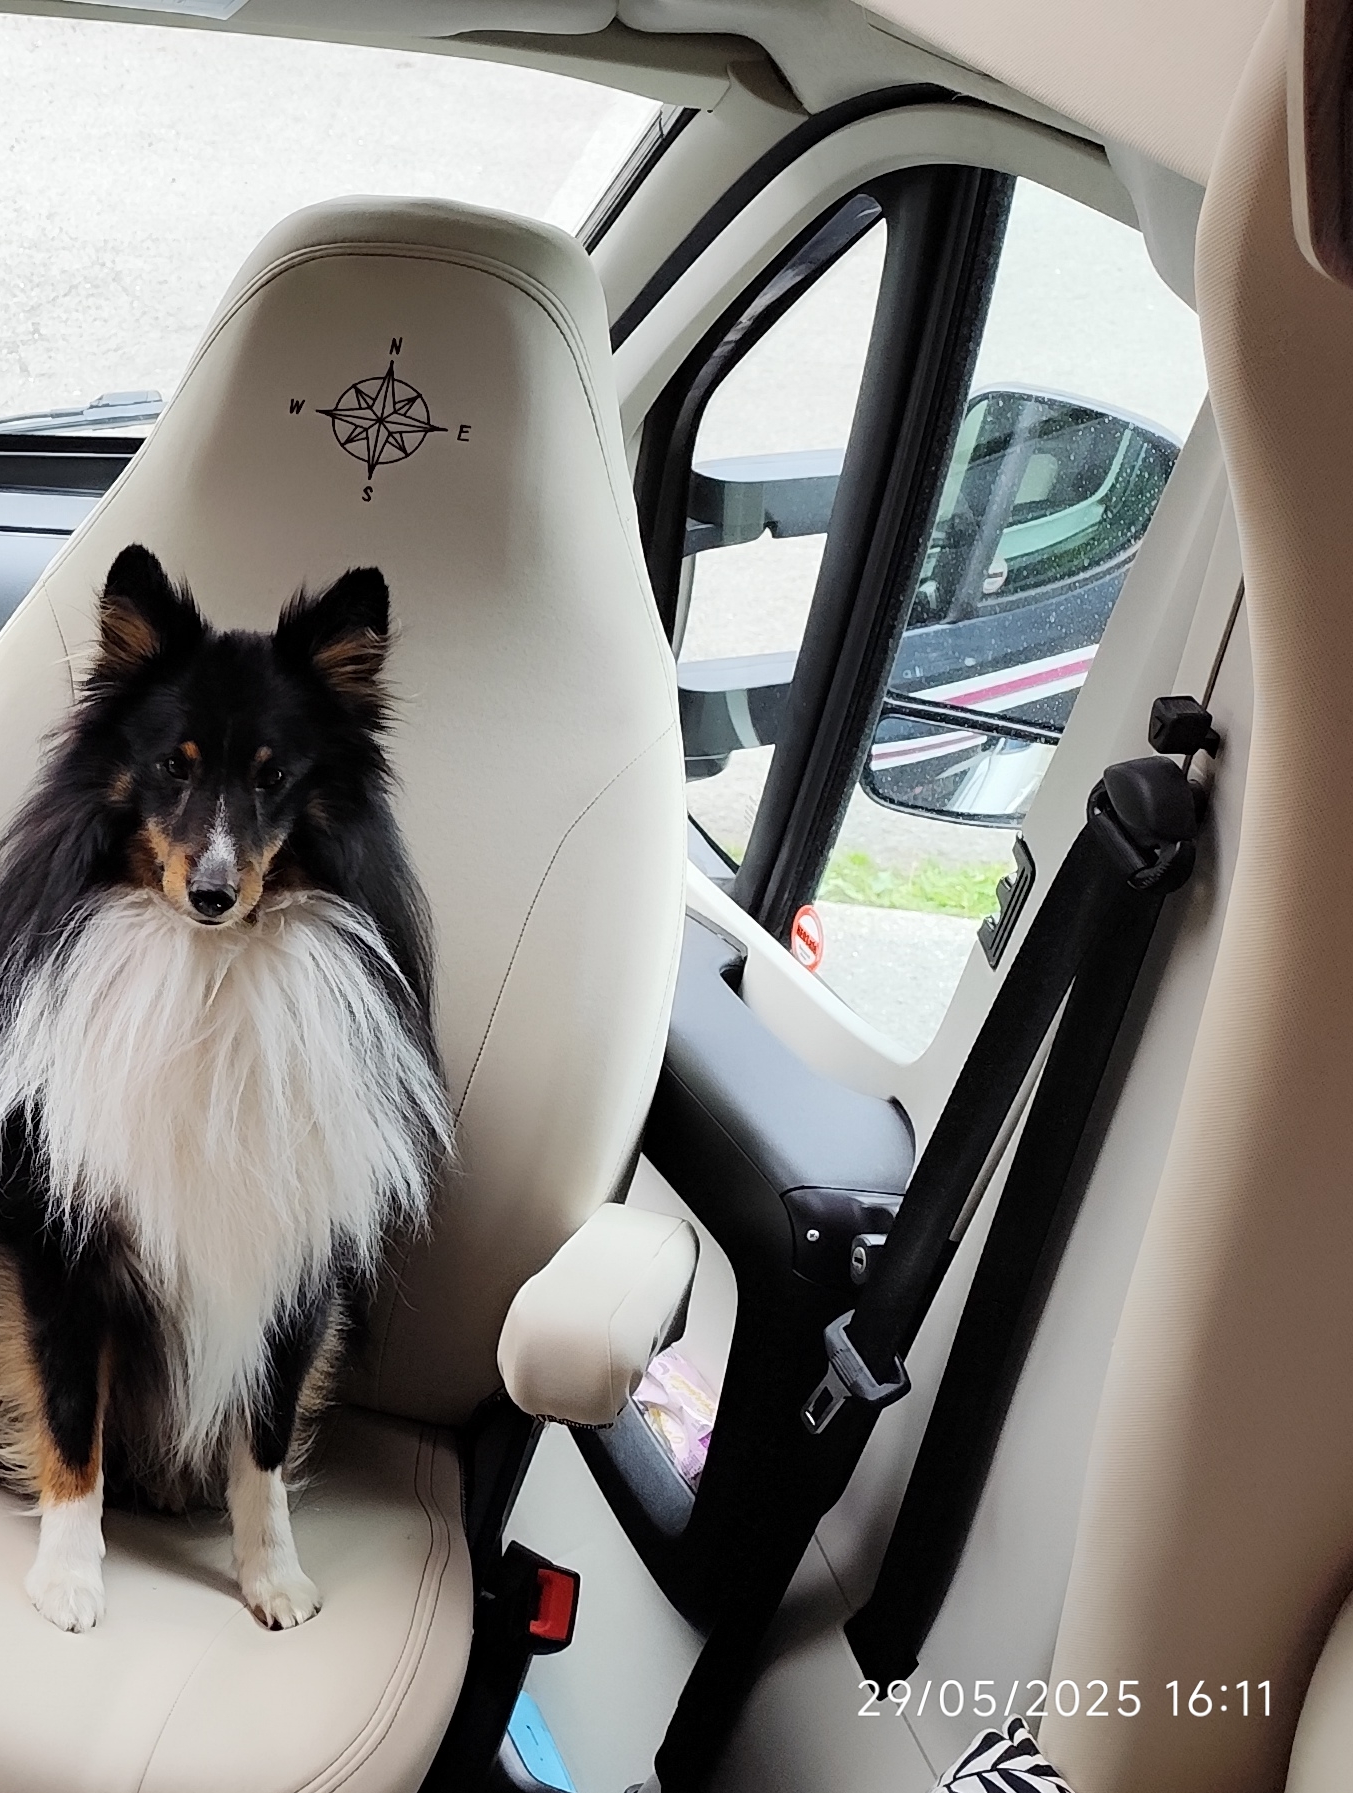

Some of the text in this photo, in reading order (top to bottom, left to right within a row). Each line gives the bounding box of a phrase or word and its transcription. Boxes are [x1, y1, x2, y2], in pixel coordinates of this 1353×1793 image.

[390, 337, 402, 355] N
[289, 399, 305, 414] W
[457, 424, 471, 441] E
[362, 486, 374, 502] S
